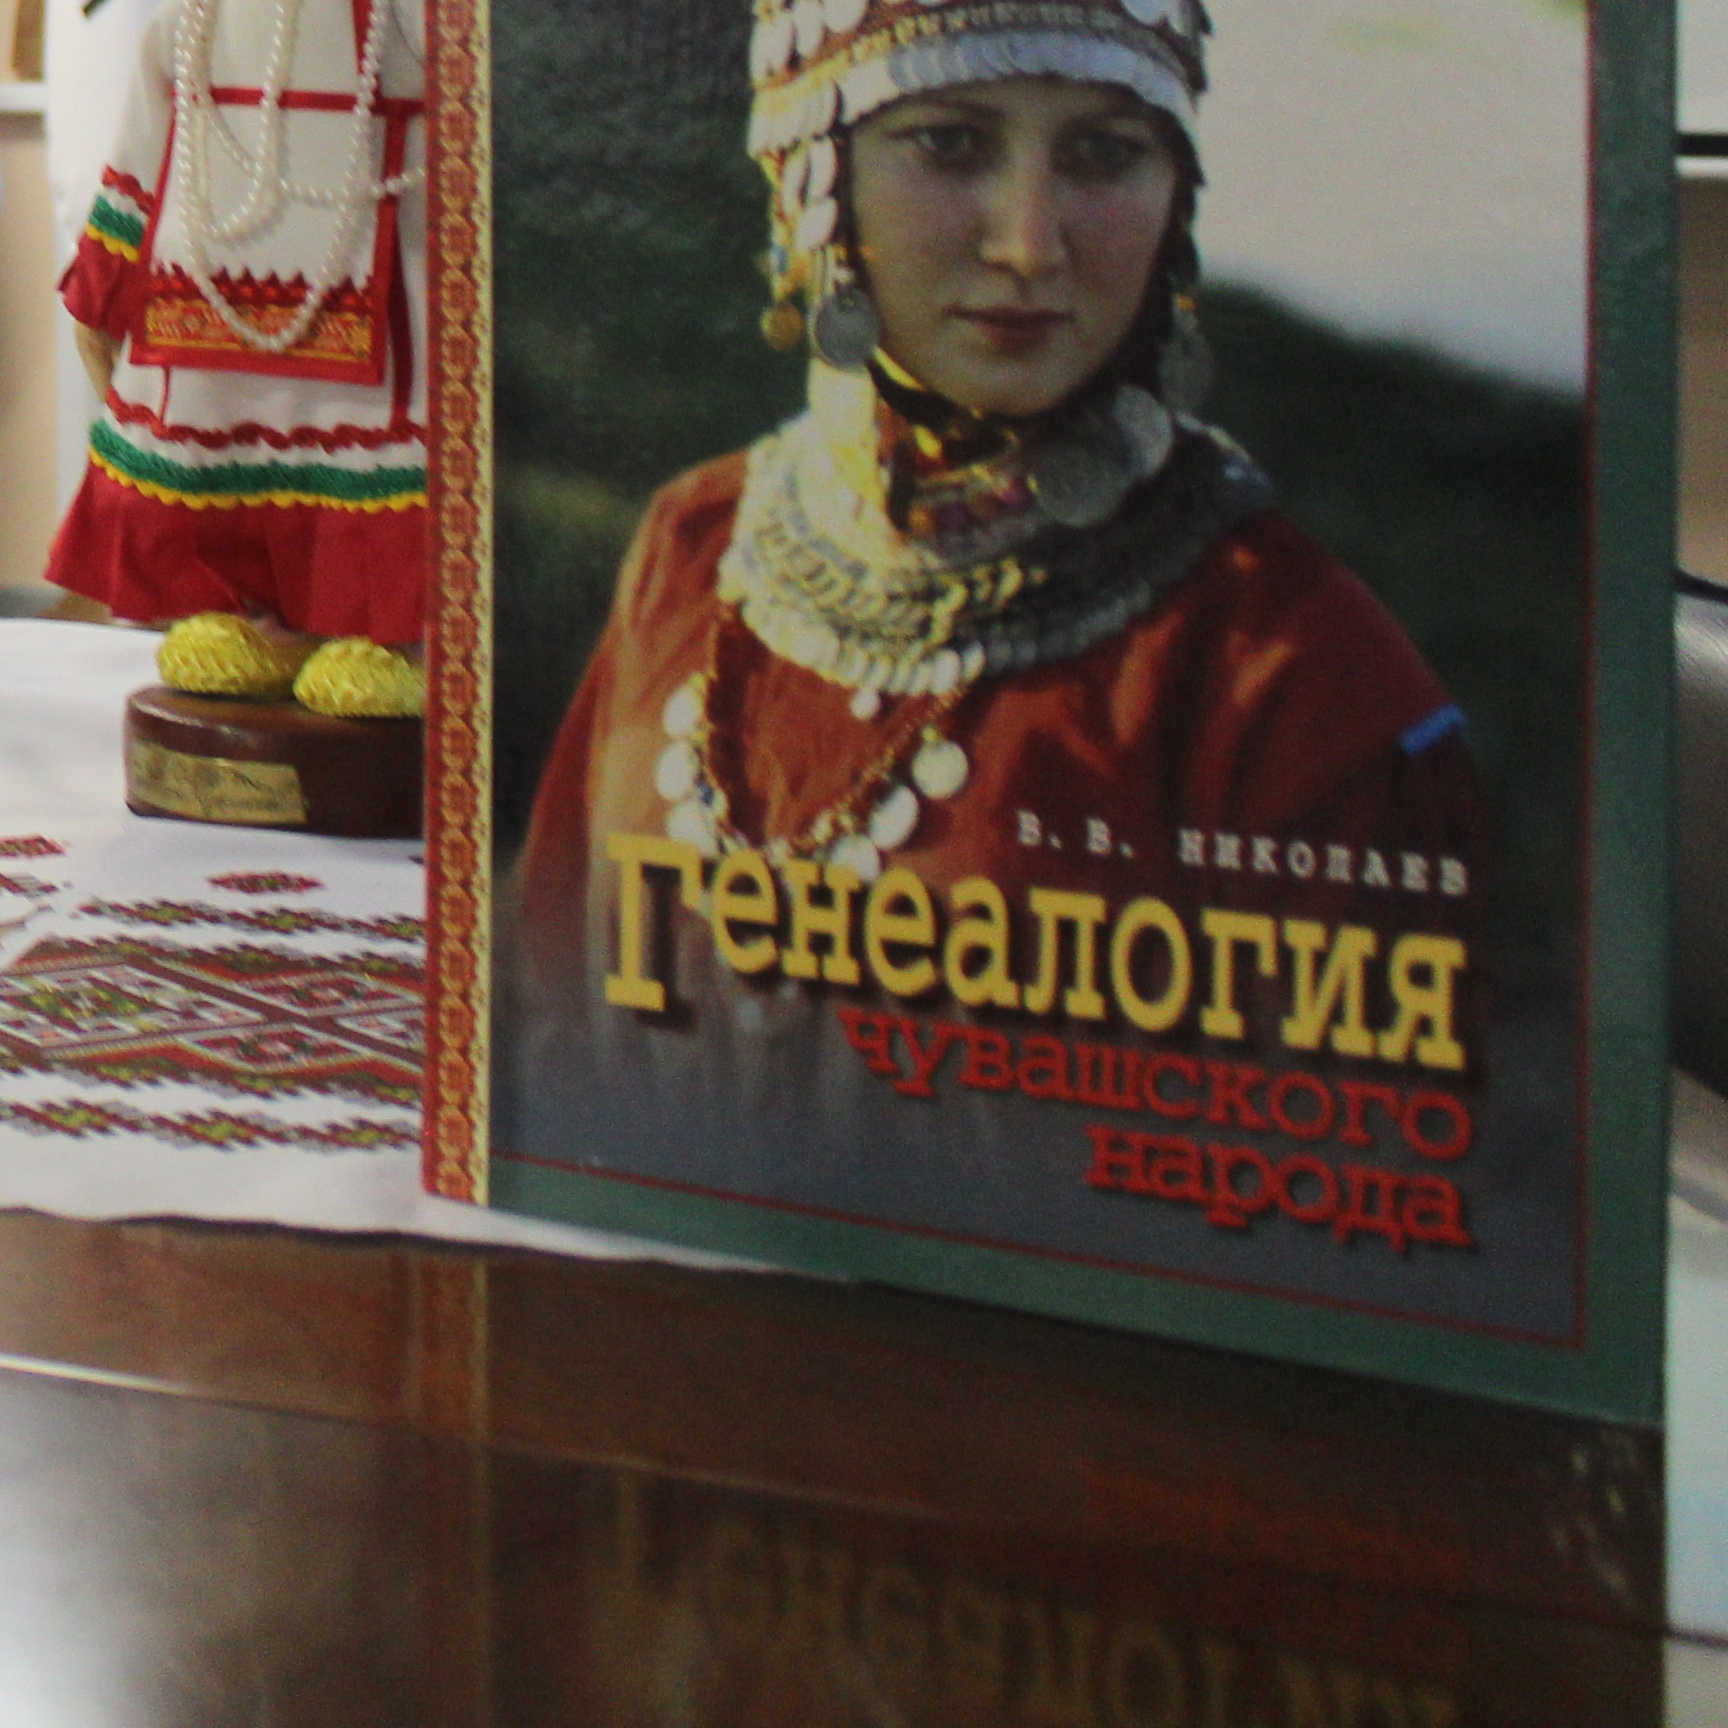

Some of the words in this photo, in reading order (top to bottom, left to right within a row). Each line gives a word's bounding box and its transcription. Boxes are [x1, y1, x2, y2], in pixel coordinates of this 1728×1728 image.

[1016, 808, 1063, 851] В.
[1085, 816, 1136, 860] В.
[1177, 826, 1470, 897] НИКОЛАЕВ
[605, 831, 1467, 1071] Генеалогия
[837, 1006, 1474, 1162] чувашского
[1083, 1122, 1473, 1252] народа
